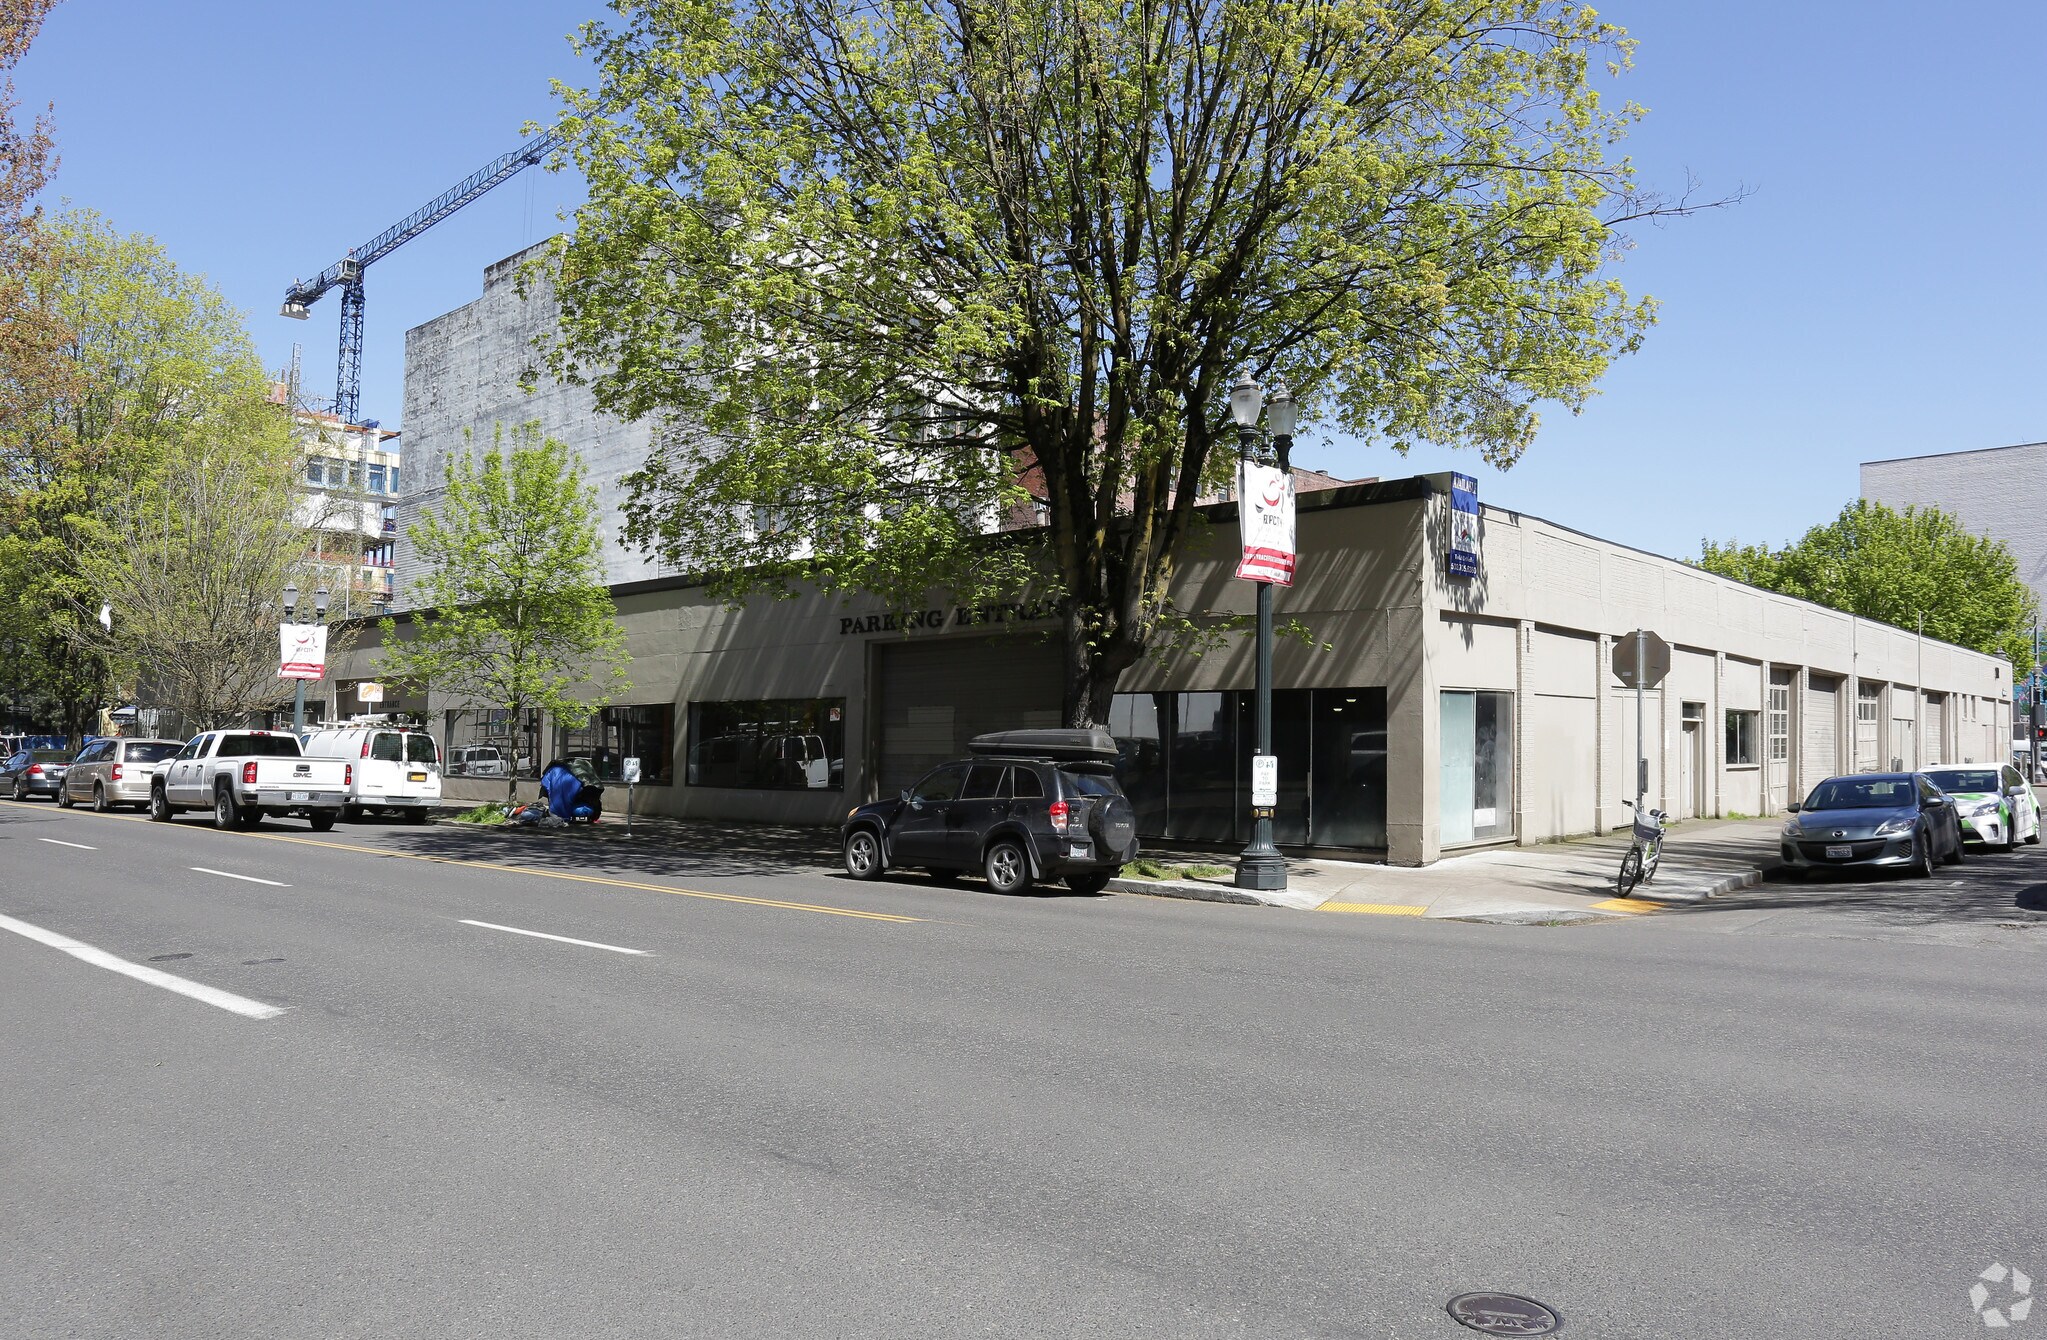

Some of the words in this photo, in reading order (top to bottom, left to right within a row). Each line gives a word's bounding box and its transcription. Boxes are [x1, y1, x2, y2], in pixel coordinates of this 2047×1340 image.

[839, 610, 944, 635] PARKING
[955, 599, 1066, 626] ENTRAN
[379, 700, 400, 709] ENTRANCE
